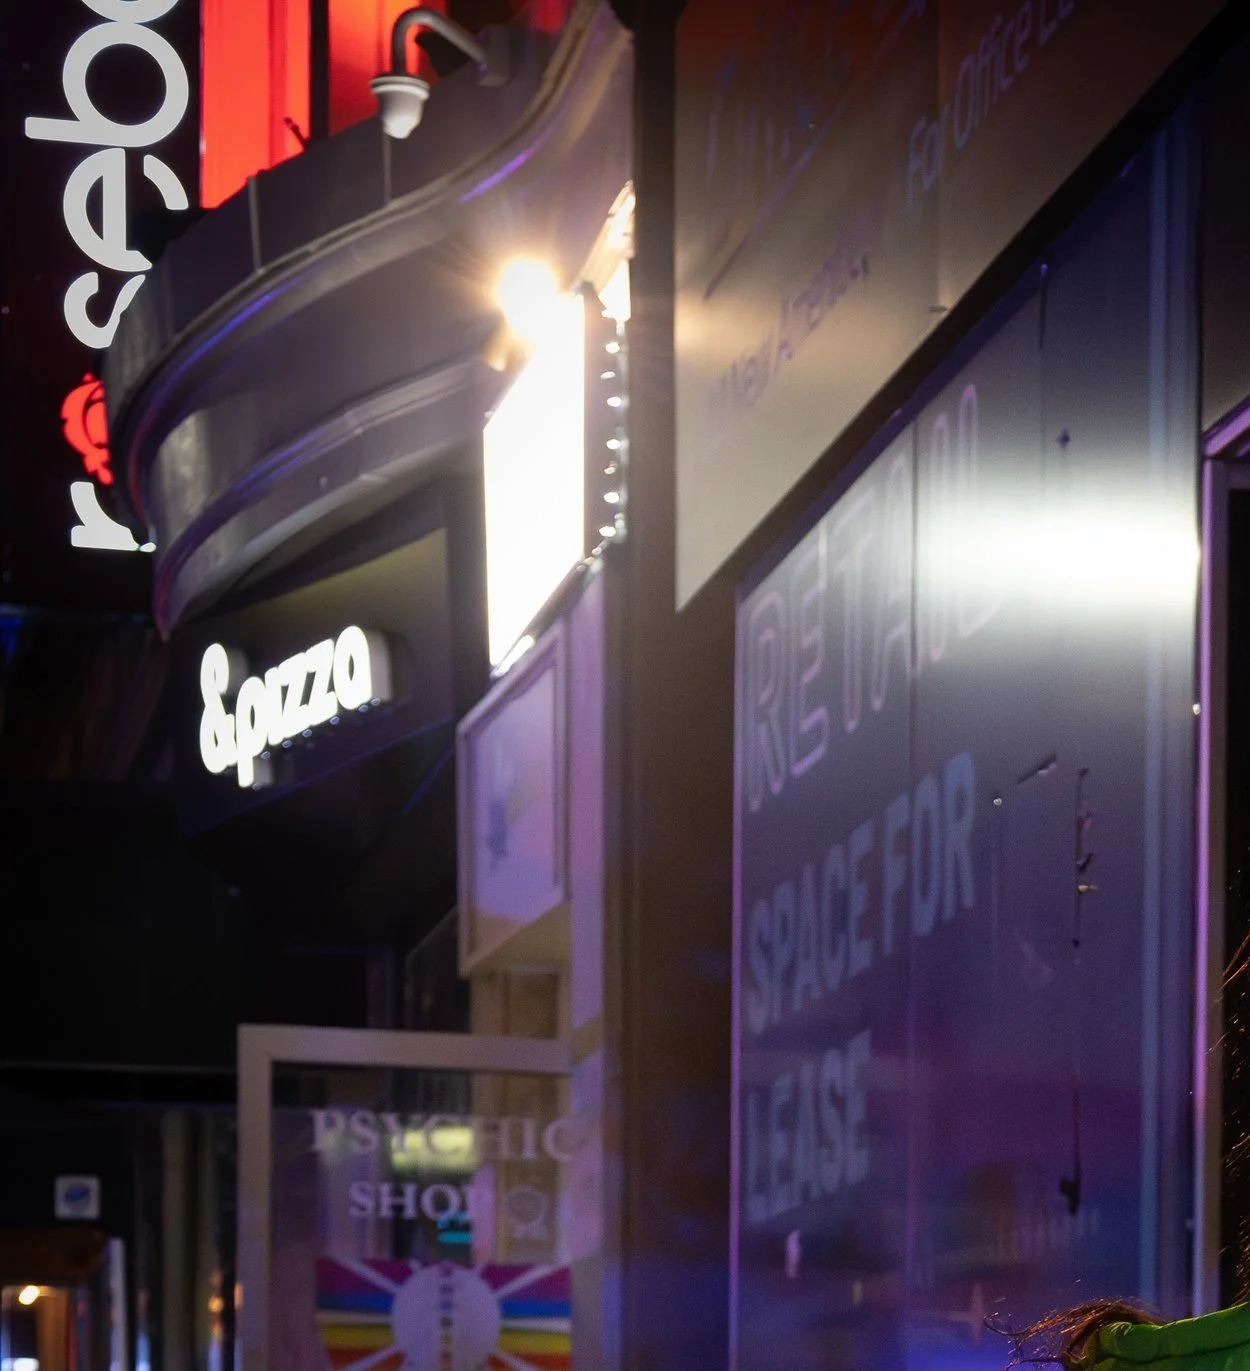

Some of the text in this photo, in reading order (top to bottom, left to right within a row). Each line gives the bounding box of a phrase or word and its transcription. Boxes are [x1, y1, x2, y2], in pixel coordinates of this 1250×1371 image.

[954, 0, 1032, 150] Office
[25, 0, 190, 553] rseb
[200, 625, 373, 788] &pizza
[747, 752, 977, 1036] SPACE FOR
[308, 1108, 578, 1163] PSYCHIC
[350, 1181, 495, 1223] SHOP
[744, 1028, 873, 1226] LEASE
